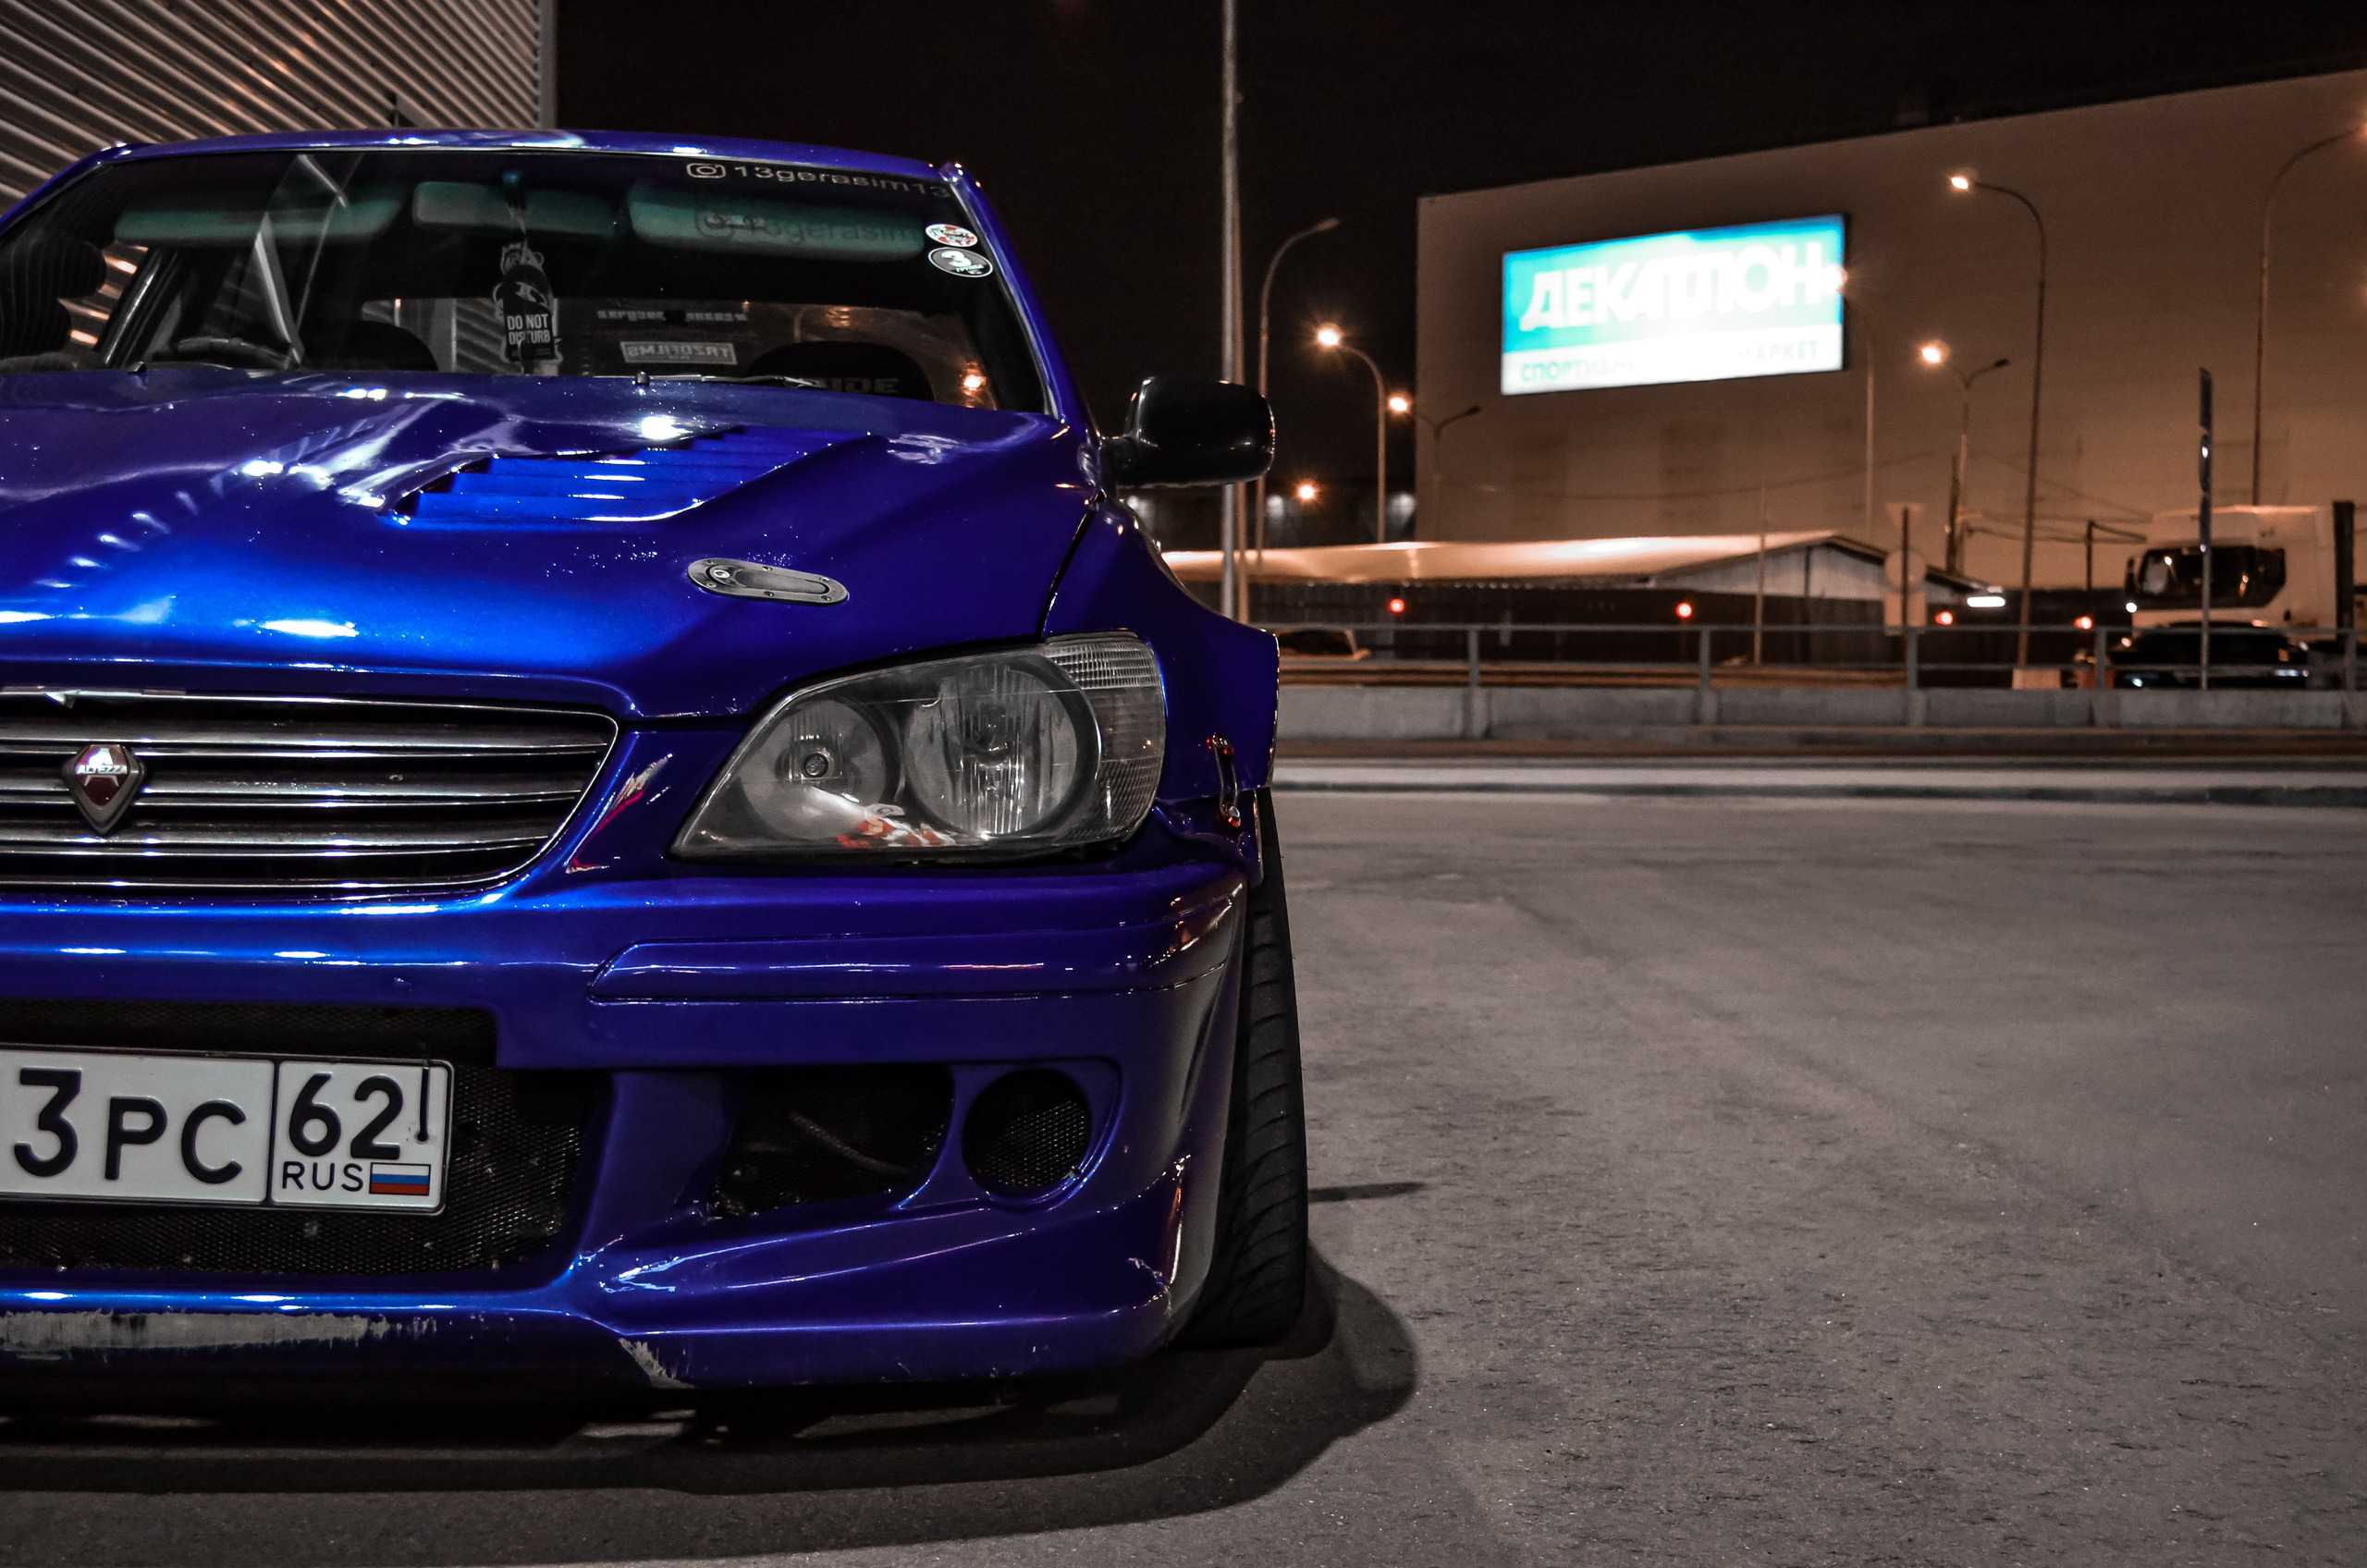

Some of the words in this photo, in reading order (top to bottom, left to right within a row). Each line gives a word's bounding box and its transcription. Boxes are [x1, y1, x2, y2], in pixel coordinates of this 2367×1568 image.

[734, 165, 950, 199] 13gerasim13
[1521, 240, 1822, 330] ДЕКАТЛОН
[508, 315, 523, 329] DO
[526, 313, 549, 329] NOT
[76, 765, 128, 775] ALTEZZA
[288, 1072, 404, 1160] 62
[281, 1160, 364, 1193] RUS
